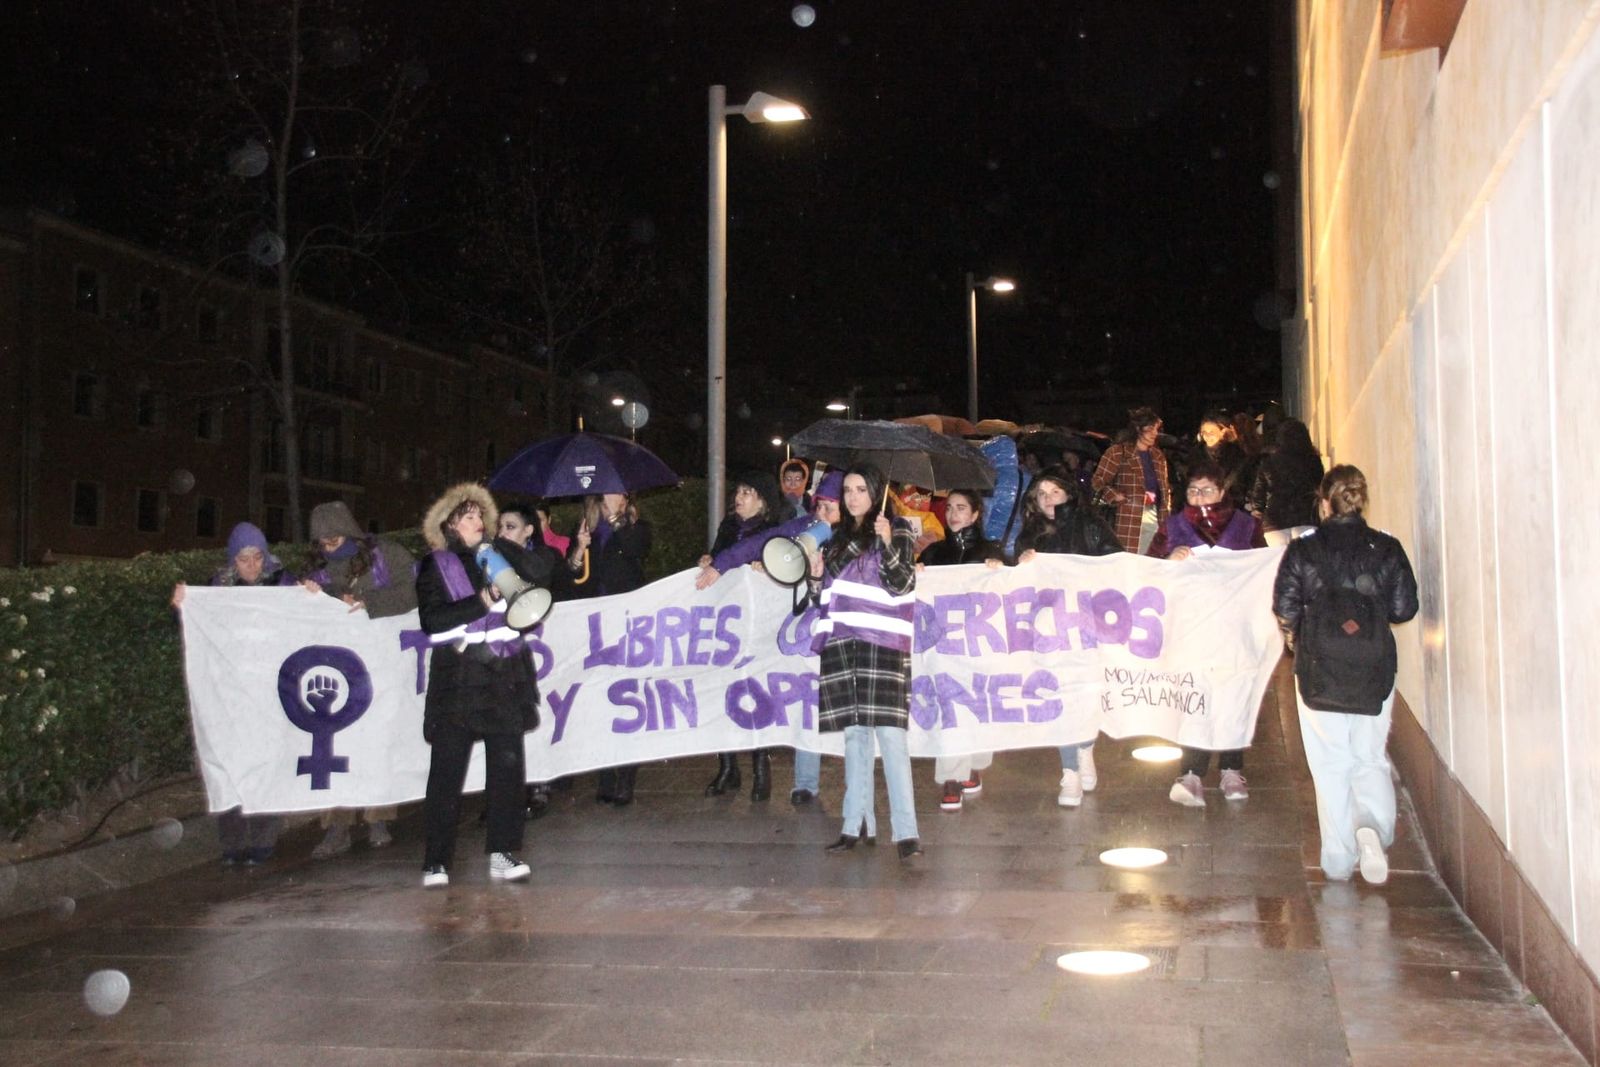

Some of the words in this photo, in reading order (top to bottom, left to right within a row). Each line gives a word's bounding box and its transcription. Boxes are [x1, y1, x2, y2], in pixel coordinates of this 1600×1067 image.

[777, 606, 822, 657] CO
[913, 586, 1166, 659] DERECHOS
[546, 683, 583, 745] Y
